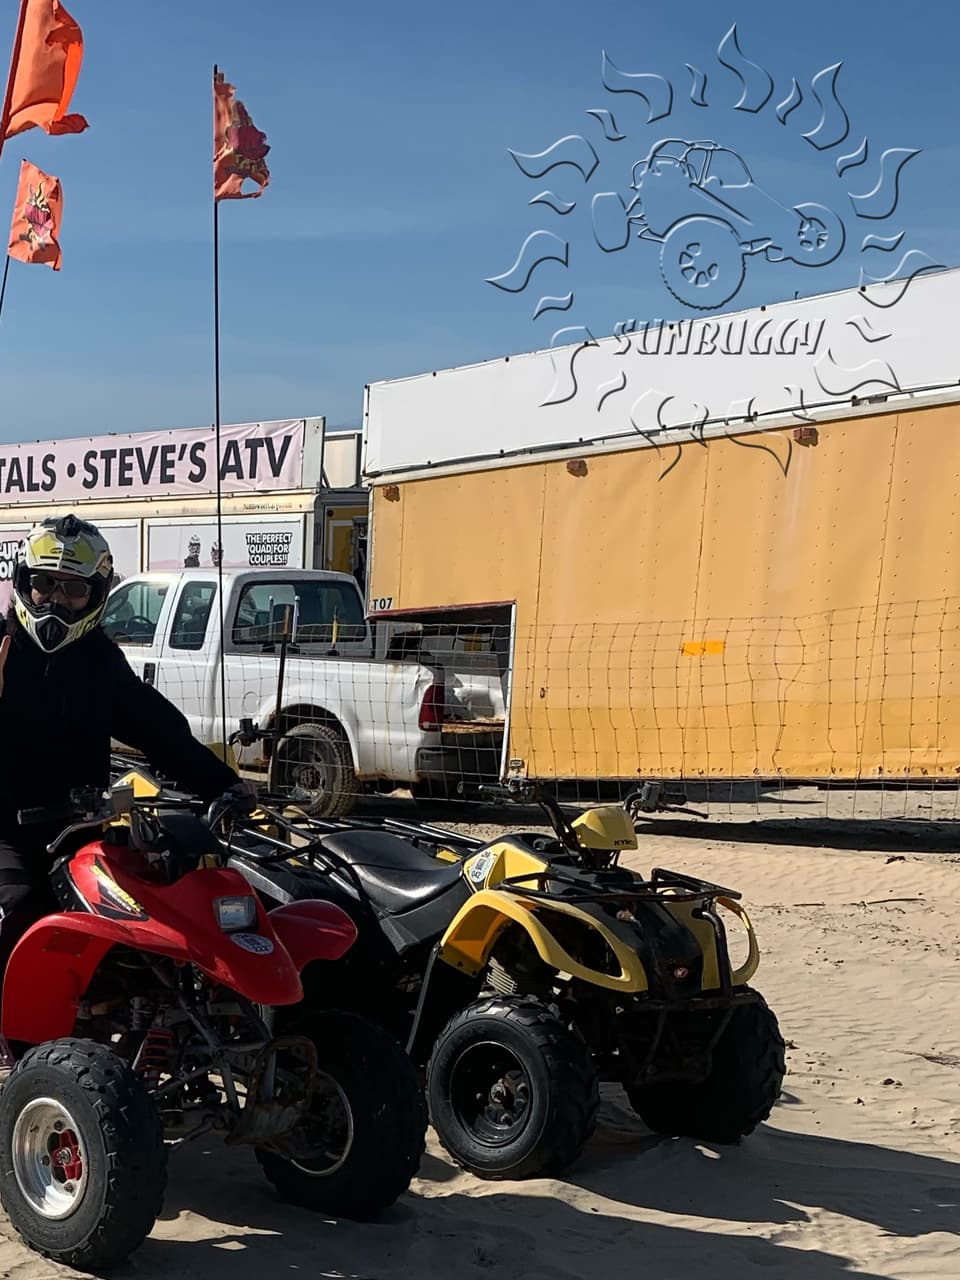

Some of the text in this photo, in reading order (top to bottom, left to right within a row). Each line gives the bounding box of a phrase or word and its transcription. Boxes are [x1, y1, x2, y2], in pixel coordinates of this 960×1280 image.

[82, 441, 207, 490] STEVE'S
[220, 434, 293, 481] ATV
[247, 533, 292, 543] THE PERFECT
[249, 543, 289, 554] QUAD FOR
